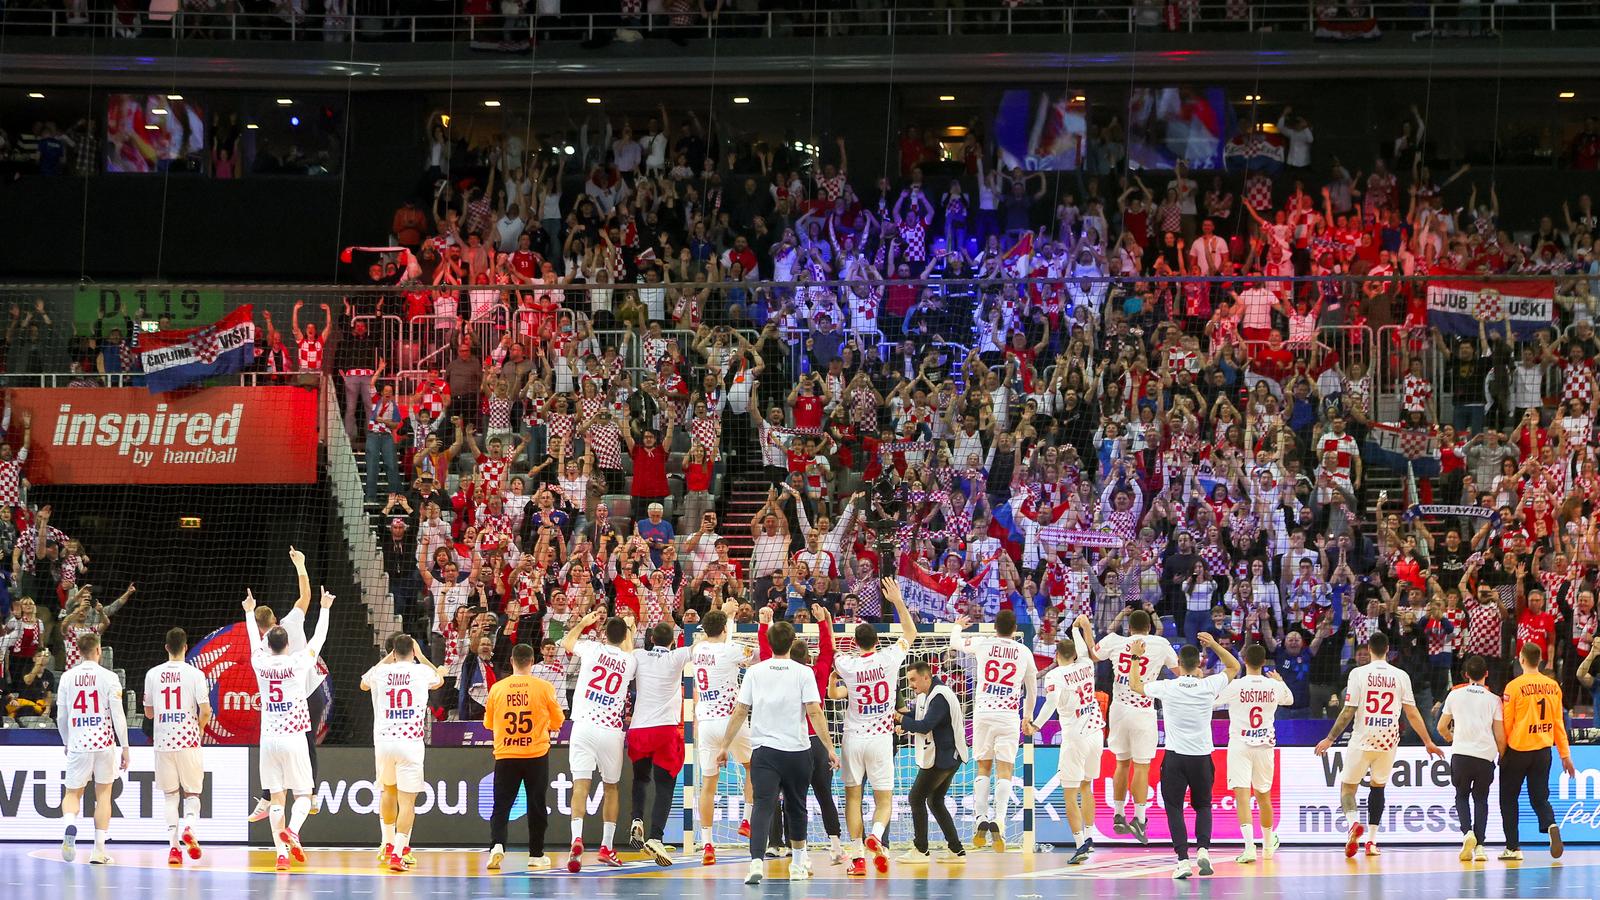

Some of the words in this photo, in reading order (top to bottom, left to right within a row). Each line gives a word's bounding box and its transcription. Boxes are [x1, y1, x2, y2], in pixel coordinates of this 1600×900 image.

[99, 289, 121, 319] D
[134, 289, 201, 320] 119
[1432, 291, 1468, 310] LJUB
[1509, 299, 1546, 317] UŠKI
[52, 403, 244, 455] inspired
[132, 448, 154, 467] by
[162, 447, 238, 464] handball
[988, 645, 1020, 660] JELINIĆ
[597, 654, 627, 674] MARAŠ
[856, 664, 886, 684] MAMIĆ
[984, 659, 1017, 687] 62
[74, 673, 97, 687] LUČIN
[160, 672, 181, 684] SRNA
[588, 665, 623, 695] 20
[697, 668, 709, 691] 9
[1367, 673, 1397, 688] ŠUŠNJA
[73, 689, 100, 714] 41
[160, 686, 182, 710] 11
[269, 680, 283, 703] 5
[385, 688, 413, 709] 10
[506, 691, 529, 707] PEŠIĆ
[594, 692, 615, 706] HEP
[855, 681, 890, 706] 30
[992, 686, 1013, 697] HEP
[1239, 689, 1275, 703] ŠOŠTARIĆ
[274, 701, 293, 712] HEP
[869, 702, 889, 714] HEP
[1365, 690, 1394, 715] 52
[1536, 697, 1546, 721] 1
[82, 716, 102, 727] HEP
[166, 713, 186, 723] HEP
[395, 709, 414, 720] HEP
[503, 711, 533, 736] 35
[1248, 706, 1263, 729] 6
[1375, 717, 1393, 727] HEP
[1250, 729, 1268, 739] HEP
[1537, 723, 1553, 733] HEP
[513, 737, 532, 747] HEP
[1391, 759, 1451, 787] are
